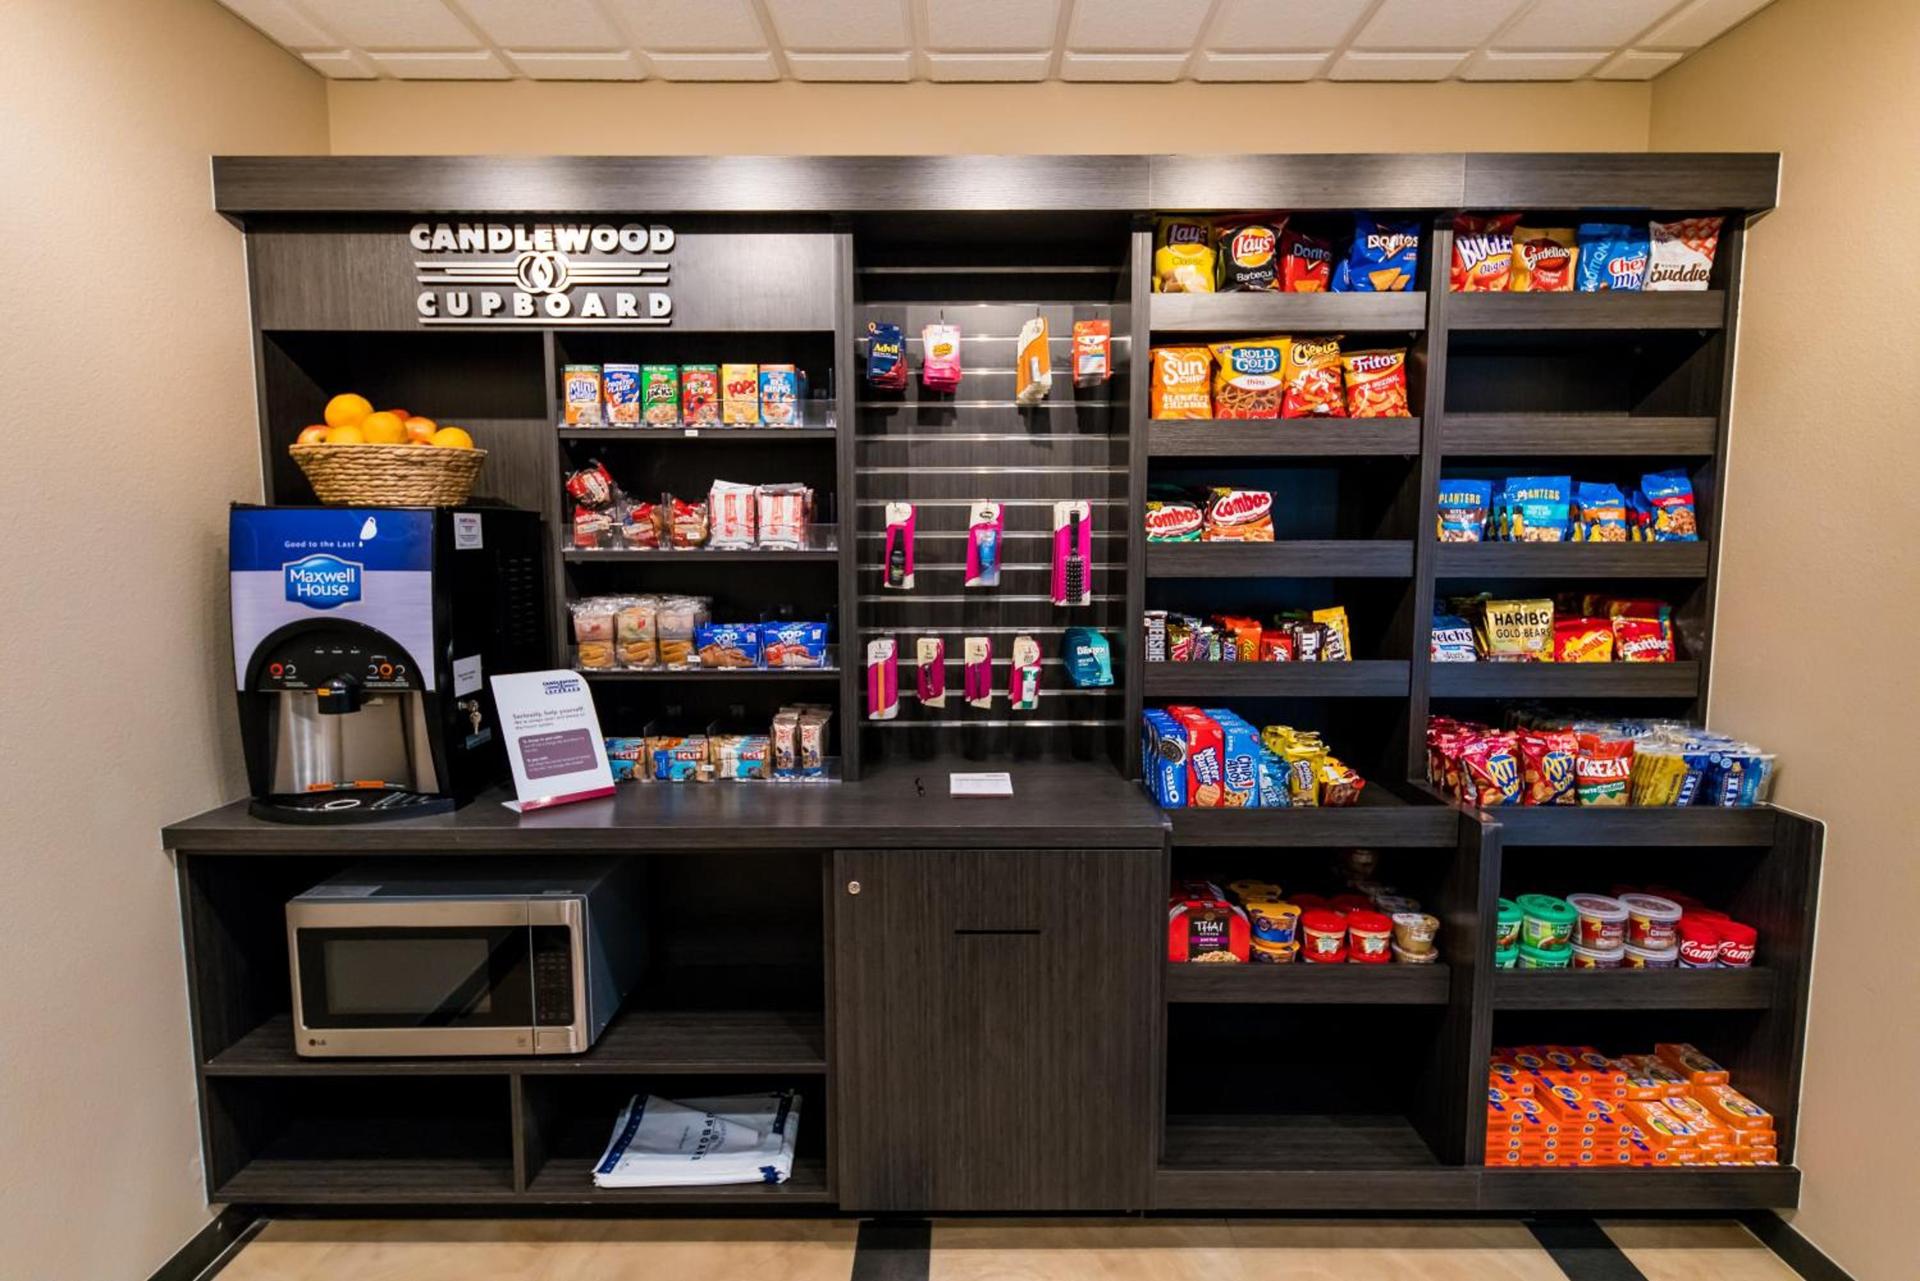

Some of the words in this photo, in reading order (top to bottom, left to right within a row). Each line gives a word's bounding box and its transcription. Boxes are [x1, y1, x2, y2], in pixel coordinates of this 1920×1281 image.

[409, 224, 675, 251] CANDLEWOOD
[1368, 233, 1418, 249] Doritos
[417, 292, 672, 317] CUPBOARD
[874, 343, 899, 354] Advil
[1240, 348, 1276, 359] ROLD
[1236, 359, 1277, 372] GOLD
[1350, 354, 1398, 372] Fritos
[1163, 361, 1206, 386] Sun
[727, 380, 756, 397] POPS
[1216, 493, 1269, 517] Combos
[1439, 492, 1481, 504] PLANTERS
[284, 540, 306, 549] Good
[309, 540, 318, 549] to
[320, 540, 335, 549] the
[338, 540, 355, 549] Last
[290, 568, 355, 584] Maxwell
[297, 583, 349, 597] House
[1494, 611, 1551, 626] HARIBO
[1203, 747, 1220, 781] Nutter
[1194, 921, 1224, 932] THAI
